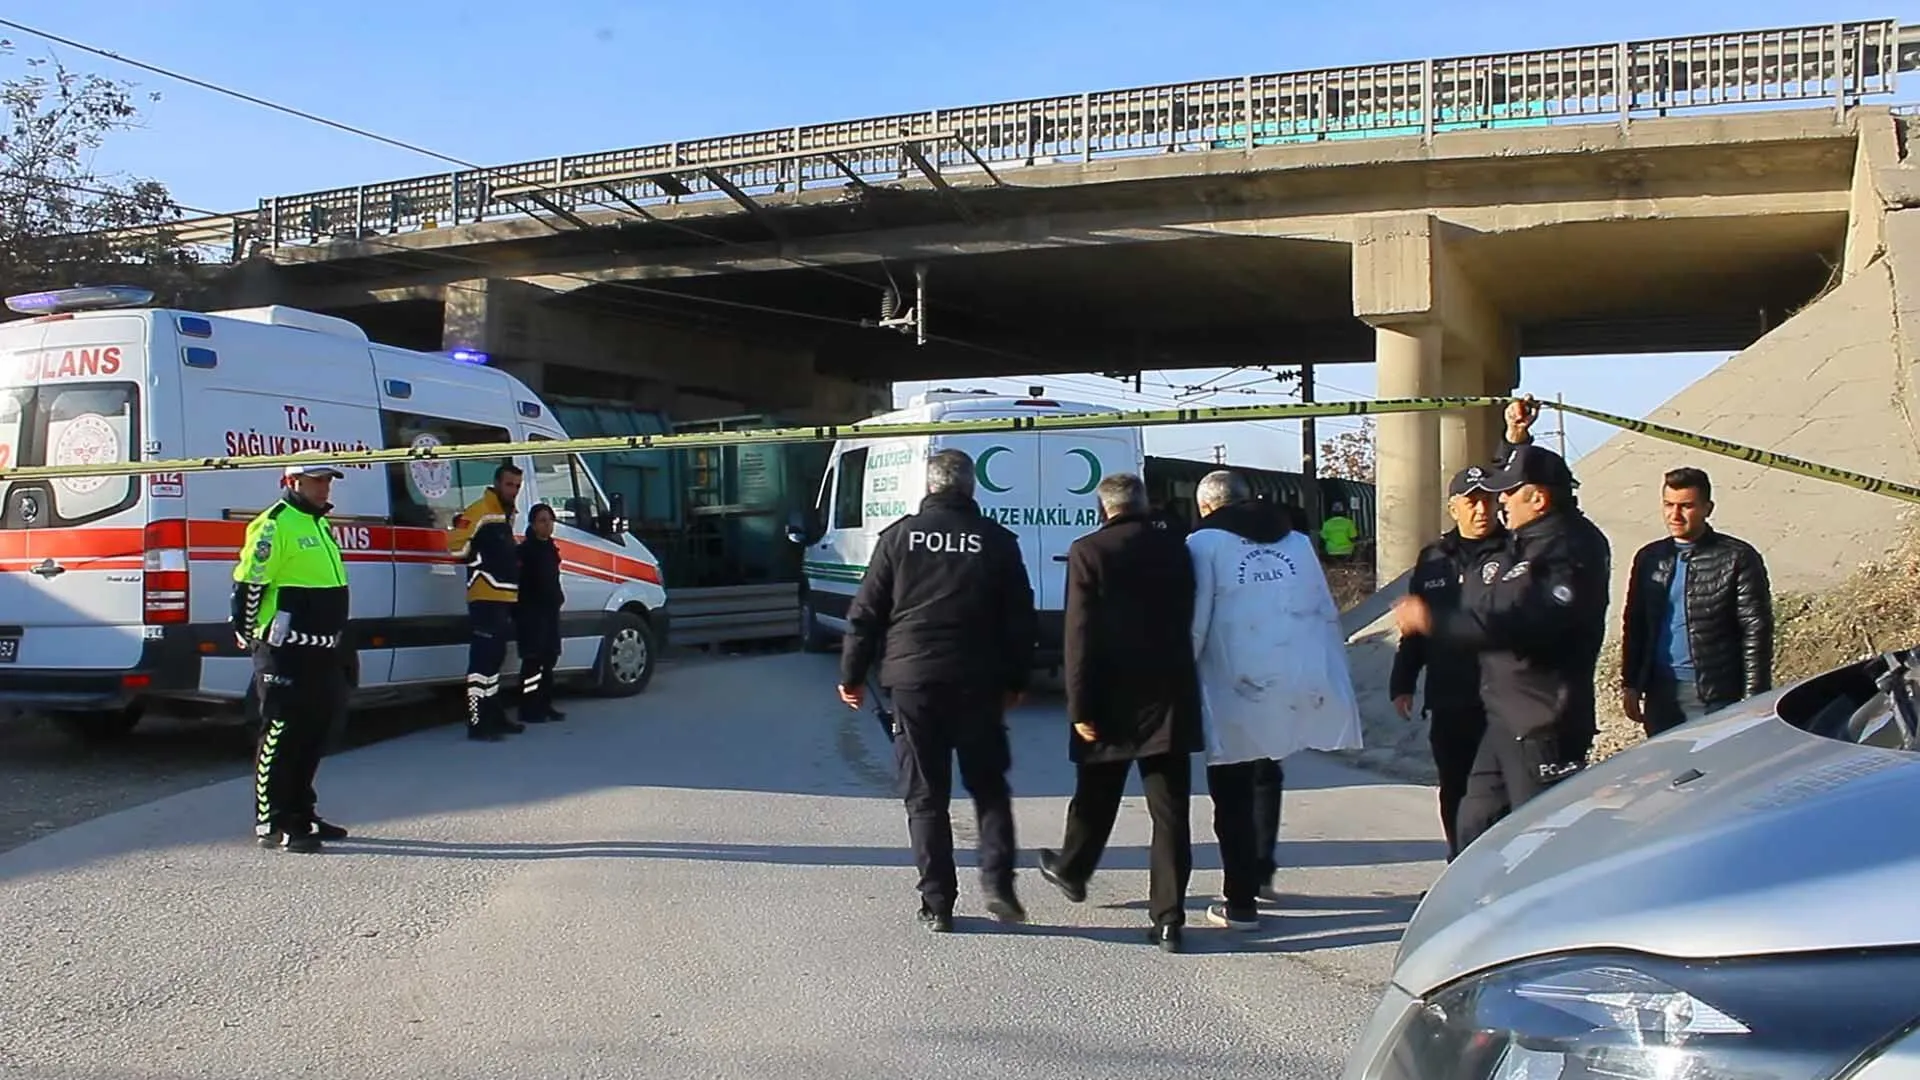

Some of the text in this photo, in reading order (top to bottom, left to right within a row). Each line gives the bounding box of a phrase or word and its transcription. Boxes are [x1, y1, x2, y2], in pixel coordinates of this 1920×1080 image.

[22, 347, 121, 380] ULANS
[284, 405, 314, 433] T.C.
[983, 503, 1102, 526] AZE NAKİL ARA
